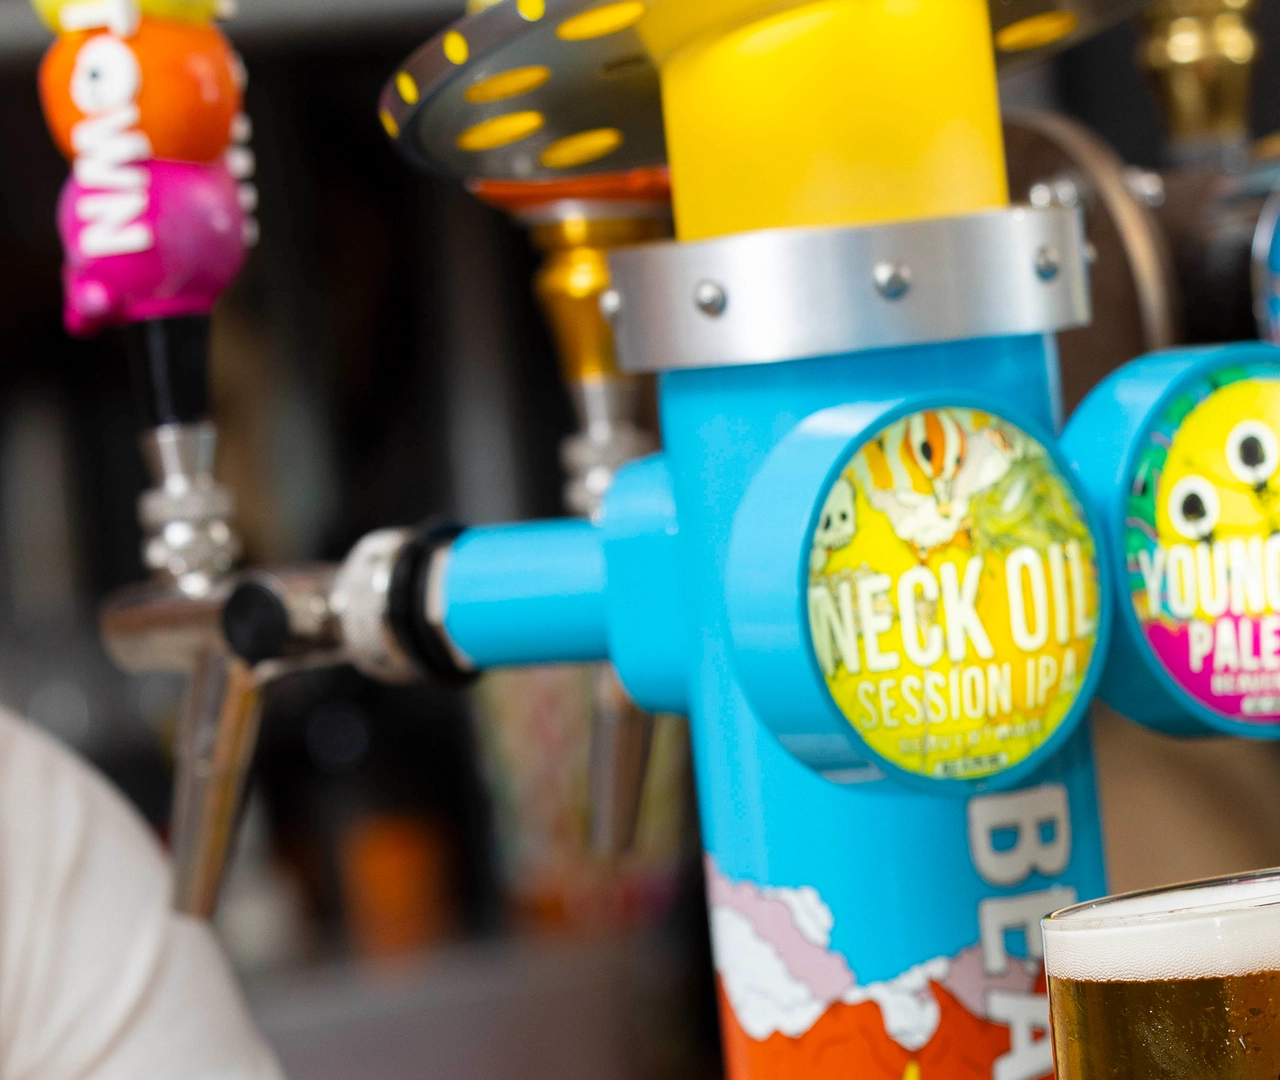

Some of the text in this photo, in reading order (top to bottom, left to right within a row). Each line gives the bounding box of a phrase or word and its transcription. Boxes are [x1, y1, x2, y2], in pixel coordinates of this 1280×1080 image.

[808, 538, 1096, 679] NECK OIL
[857, 647, 1078, 729] SESSION IPA
